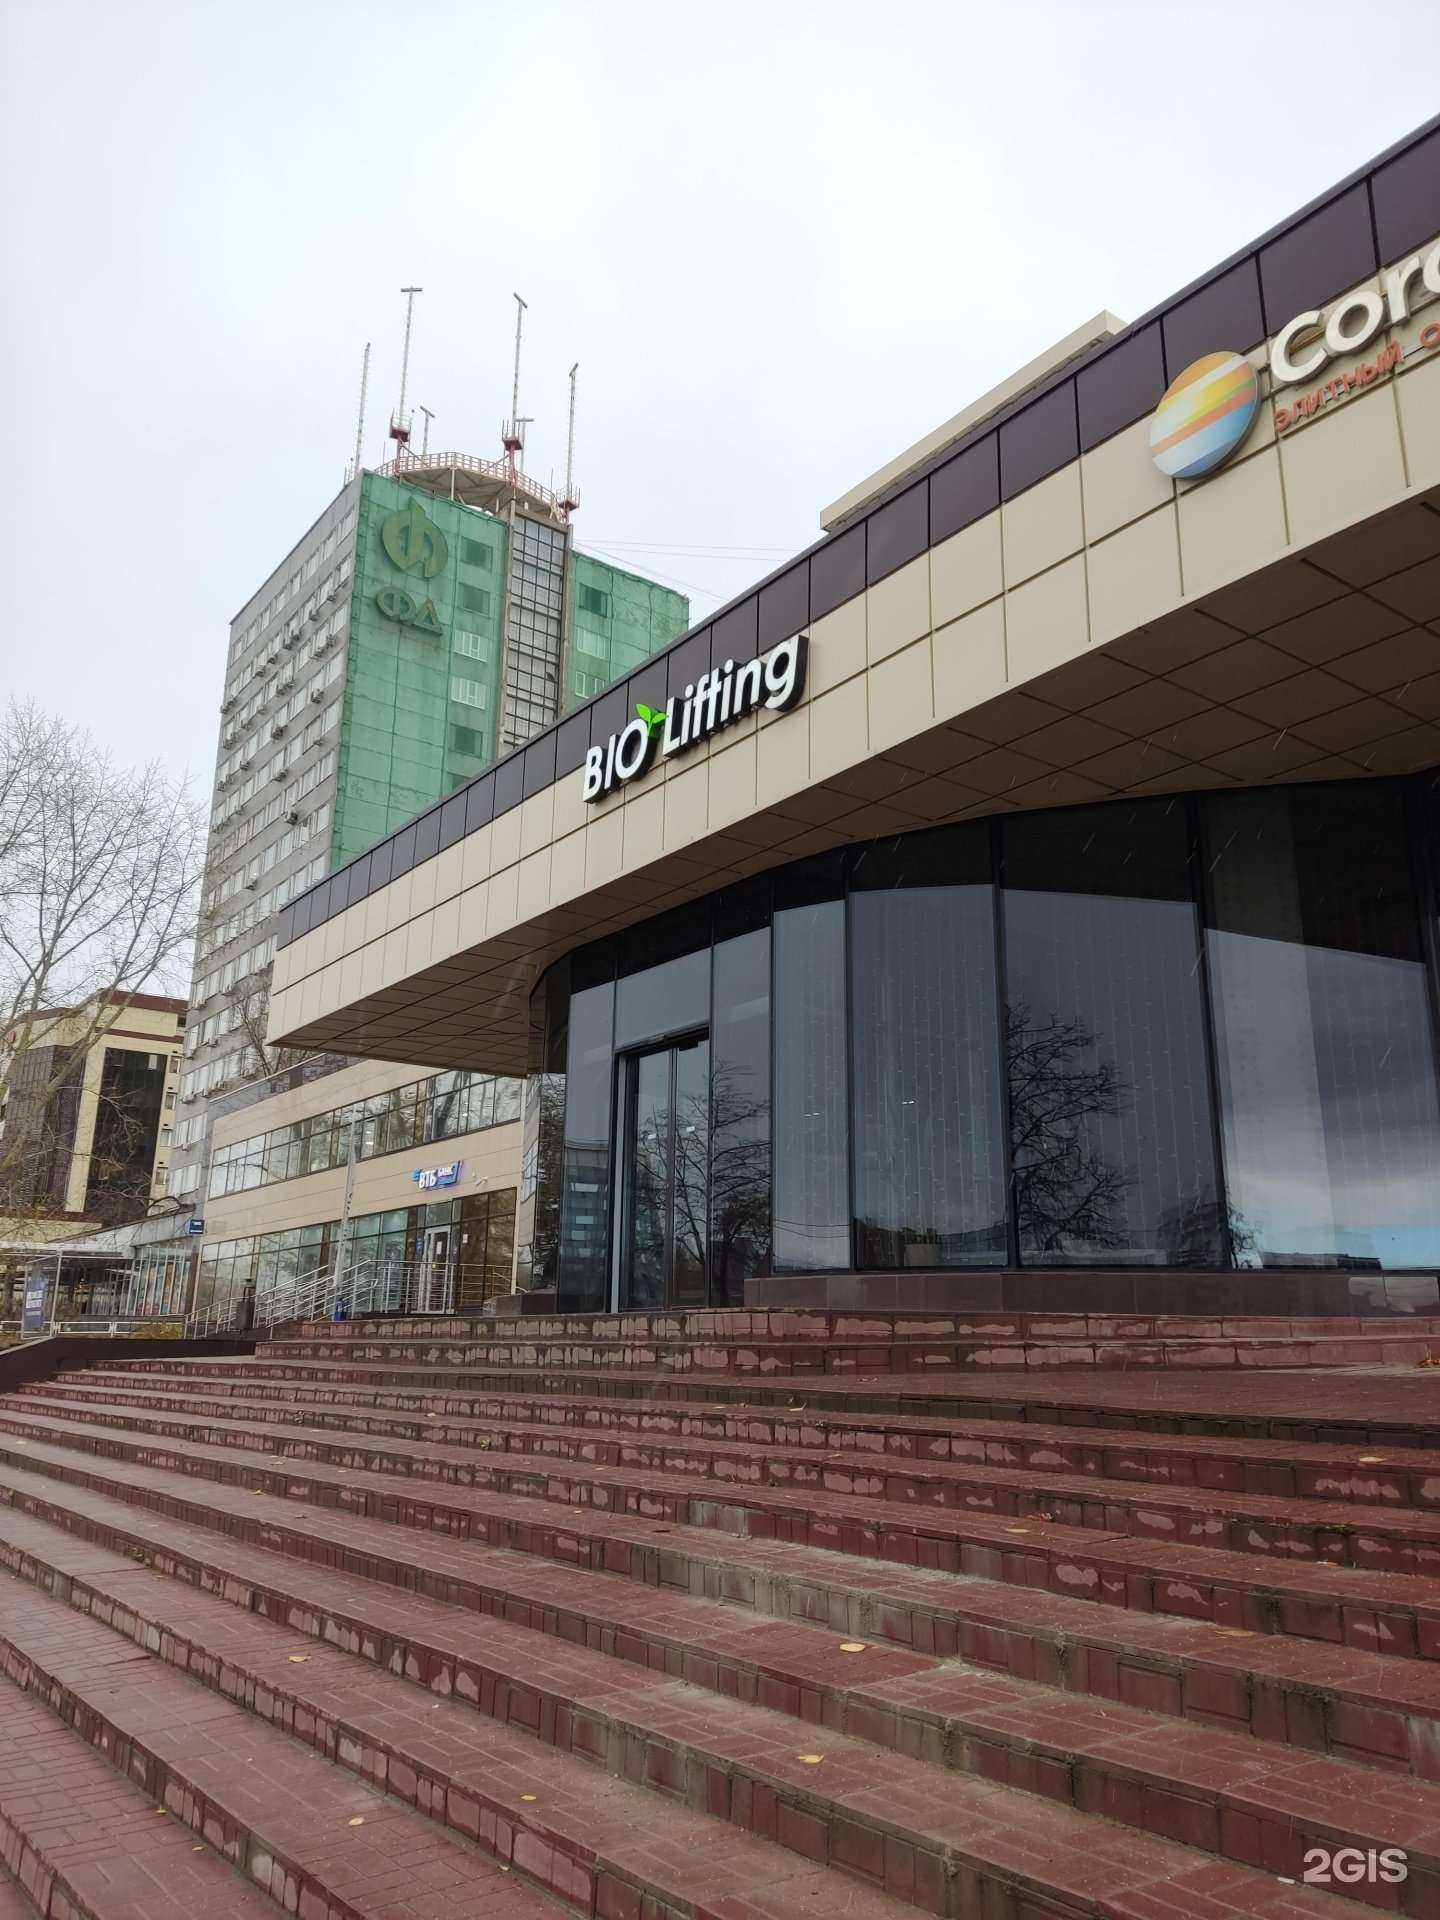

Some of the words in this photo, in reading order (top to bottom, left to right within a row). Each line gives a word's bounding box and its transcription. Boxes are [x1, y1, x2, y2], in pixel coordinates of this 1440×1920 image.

[583, 718, 651, 803] BIO
[662, 634, 808, 757] Lifting
[419, 1169, 437, 1189] ВТБ
